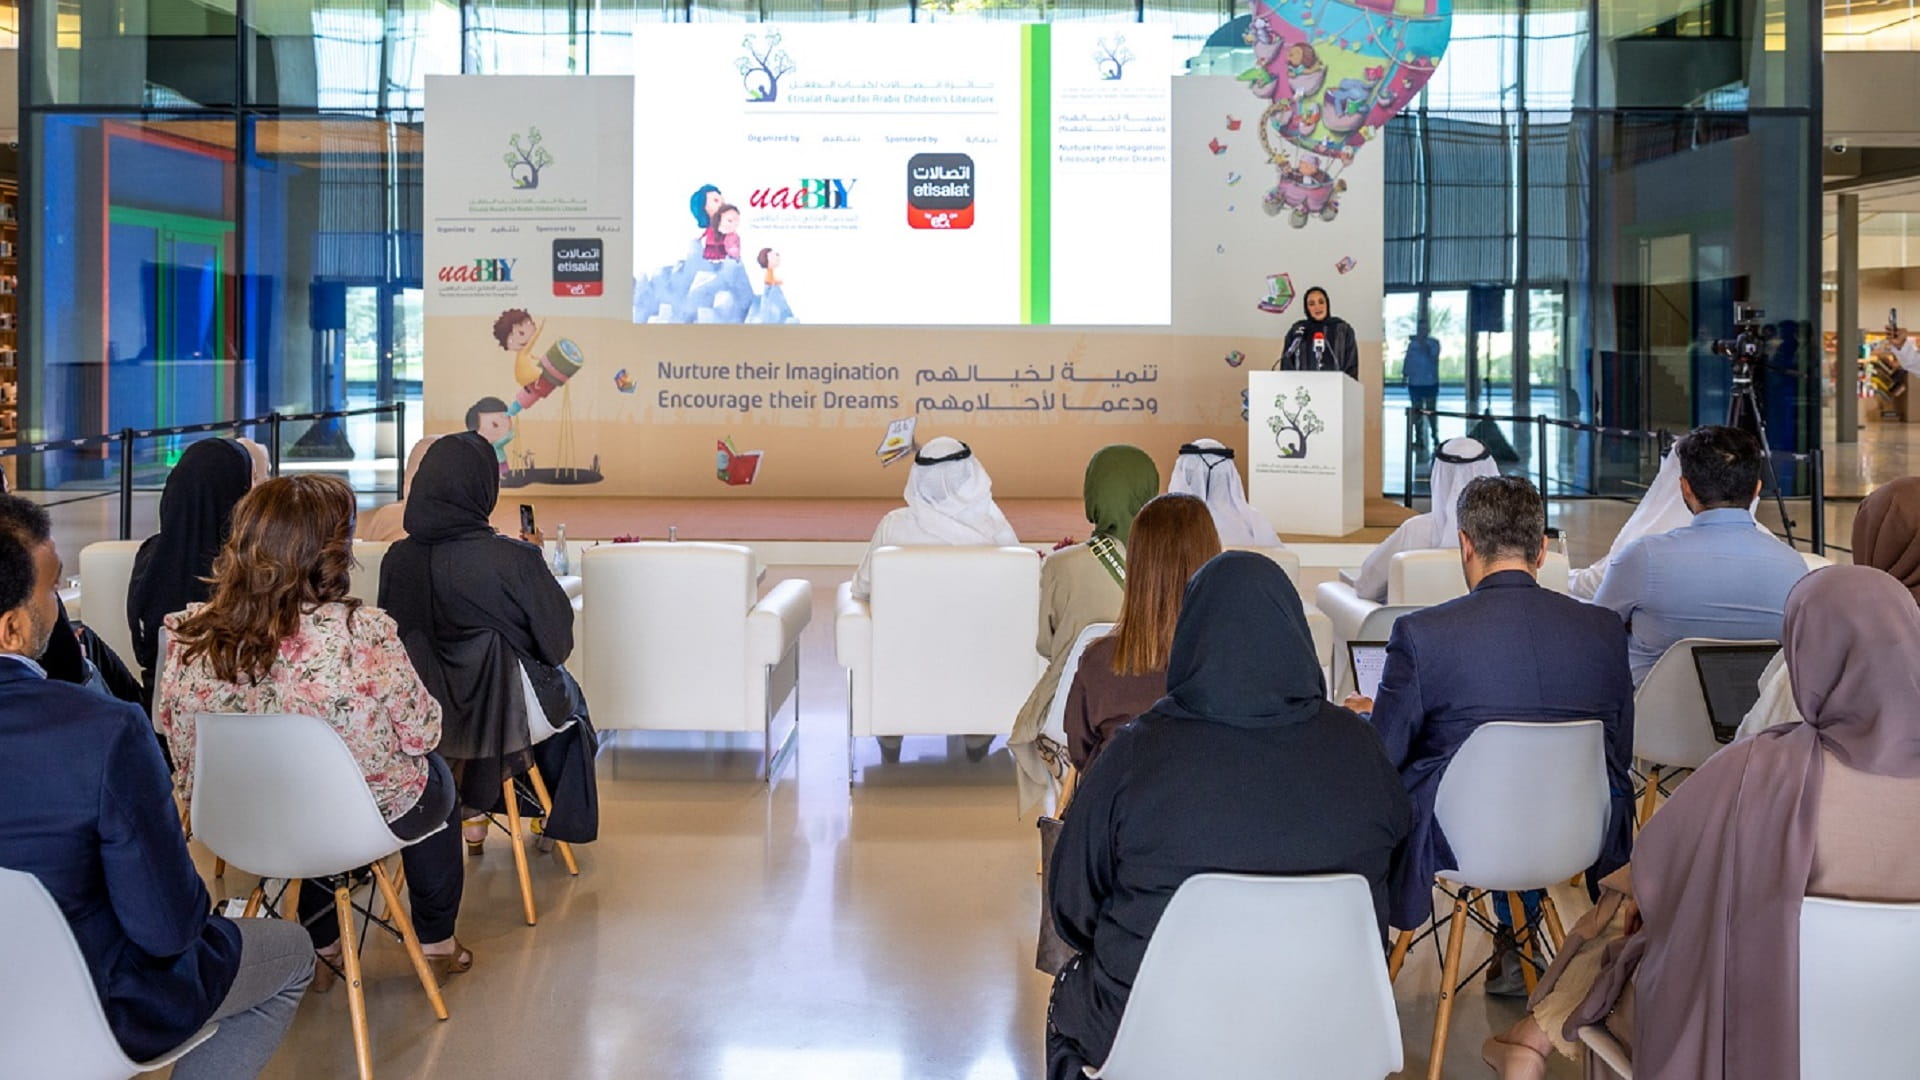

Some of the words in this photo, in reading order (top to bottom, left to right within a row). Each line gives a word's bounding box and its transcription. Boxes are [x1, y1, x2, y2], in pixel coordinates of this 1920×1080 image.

[788, 94, 822, 103] Etisalat
[825, 94, 855, 103] Award
[857, 94, 870, 103] for
[872, 94, 900, 103] Arabic
[950, 94, 994, 103] Literature
[748, 134, 788, 143] Organized
[790, 134, 800, 143] by
[885, 135, 926, 144] Sponsored
[928, 135, 938, 144] by
[913, 166, 970, 180] اتصالات
[913, 182, 970, 197] etisalat
[557, 248, 600, 259] اتصالات
[557, 261, 600, 273] etisalat
[658, 362, 730, 380] Nurture
[735, 362, 780, 380] their
[786, 362, 899, 384] Imagination
[915, 364, 1055, 388] لخيالهم
[1061, 362, 1158, 388] تنمية
[658, 390, 763, 412] Encourage
[769, 391, 817, 409] their
[824, 391, 899, 409] Dreams
[915, 390, 1055, 414] لأحلامهم
[1062, 393, 1158, 414] ودعما
